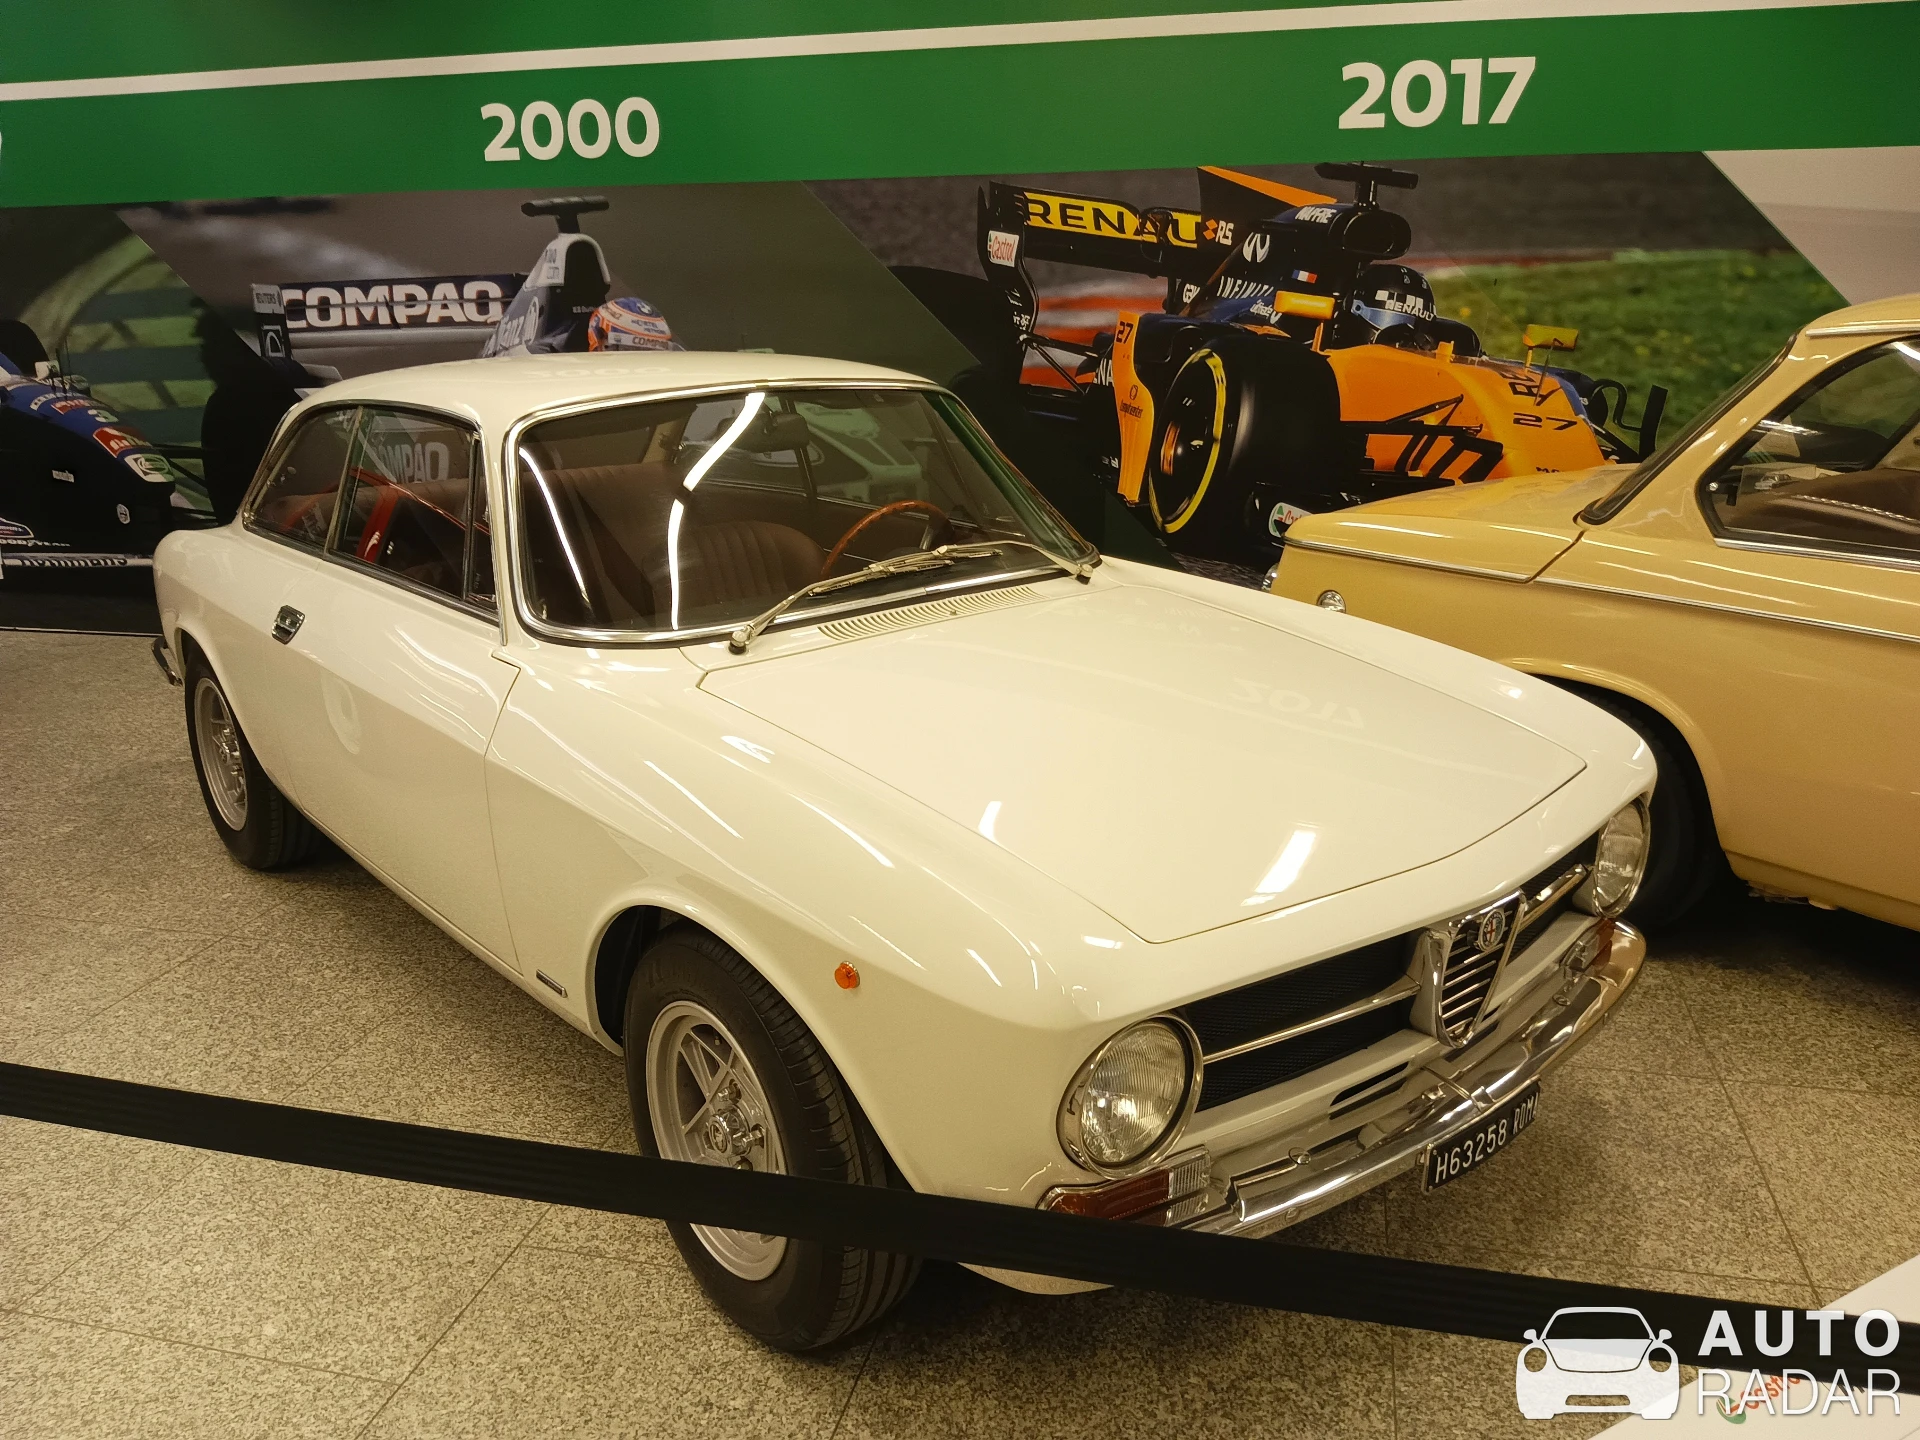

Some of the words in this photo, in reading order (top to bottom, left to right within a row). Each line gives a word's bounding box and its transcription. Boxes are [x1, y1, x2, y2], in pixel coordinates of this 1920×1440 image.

[1339, 57, 1536, 129] 2017
[481, 97, 660, 161] 2000
[1215, 221, 1234, 246] RS
[991, 236, 1015, 262] Castrol
[1216, 276, 1274, 299] INFINITI
[1116, 321, 1134, 344] 27
[1513, 412, 1578, 430] 27
[1435, 1119, 1507, 1184] H63258
